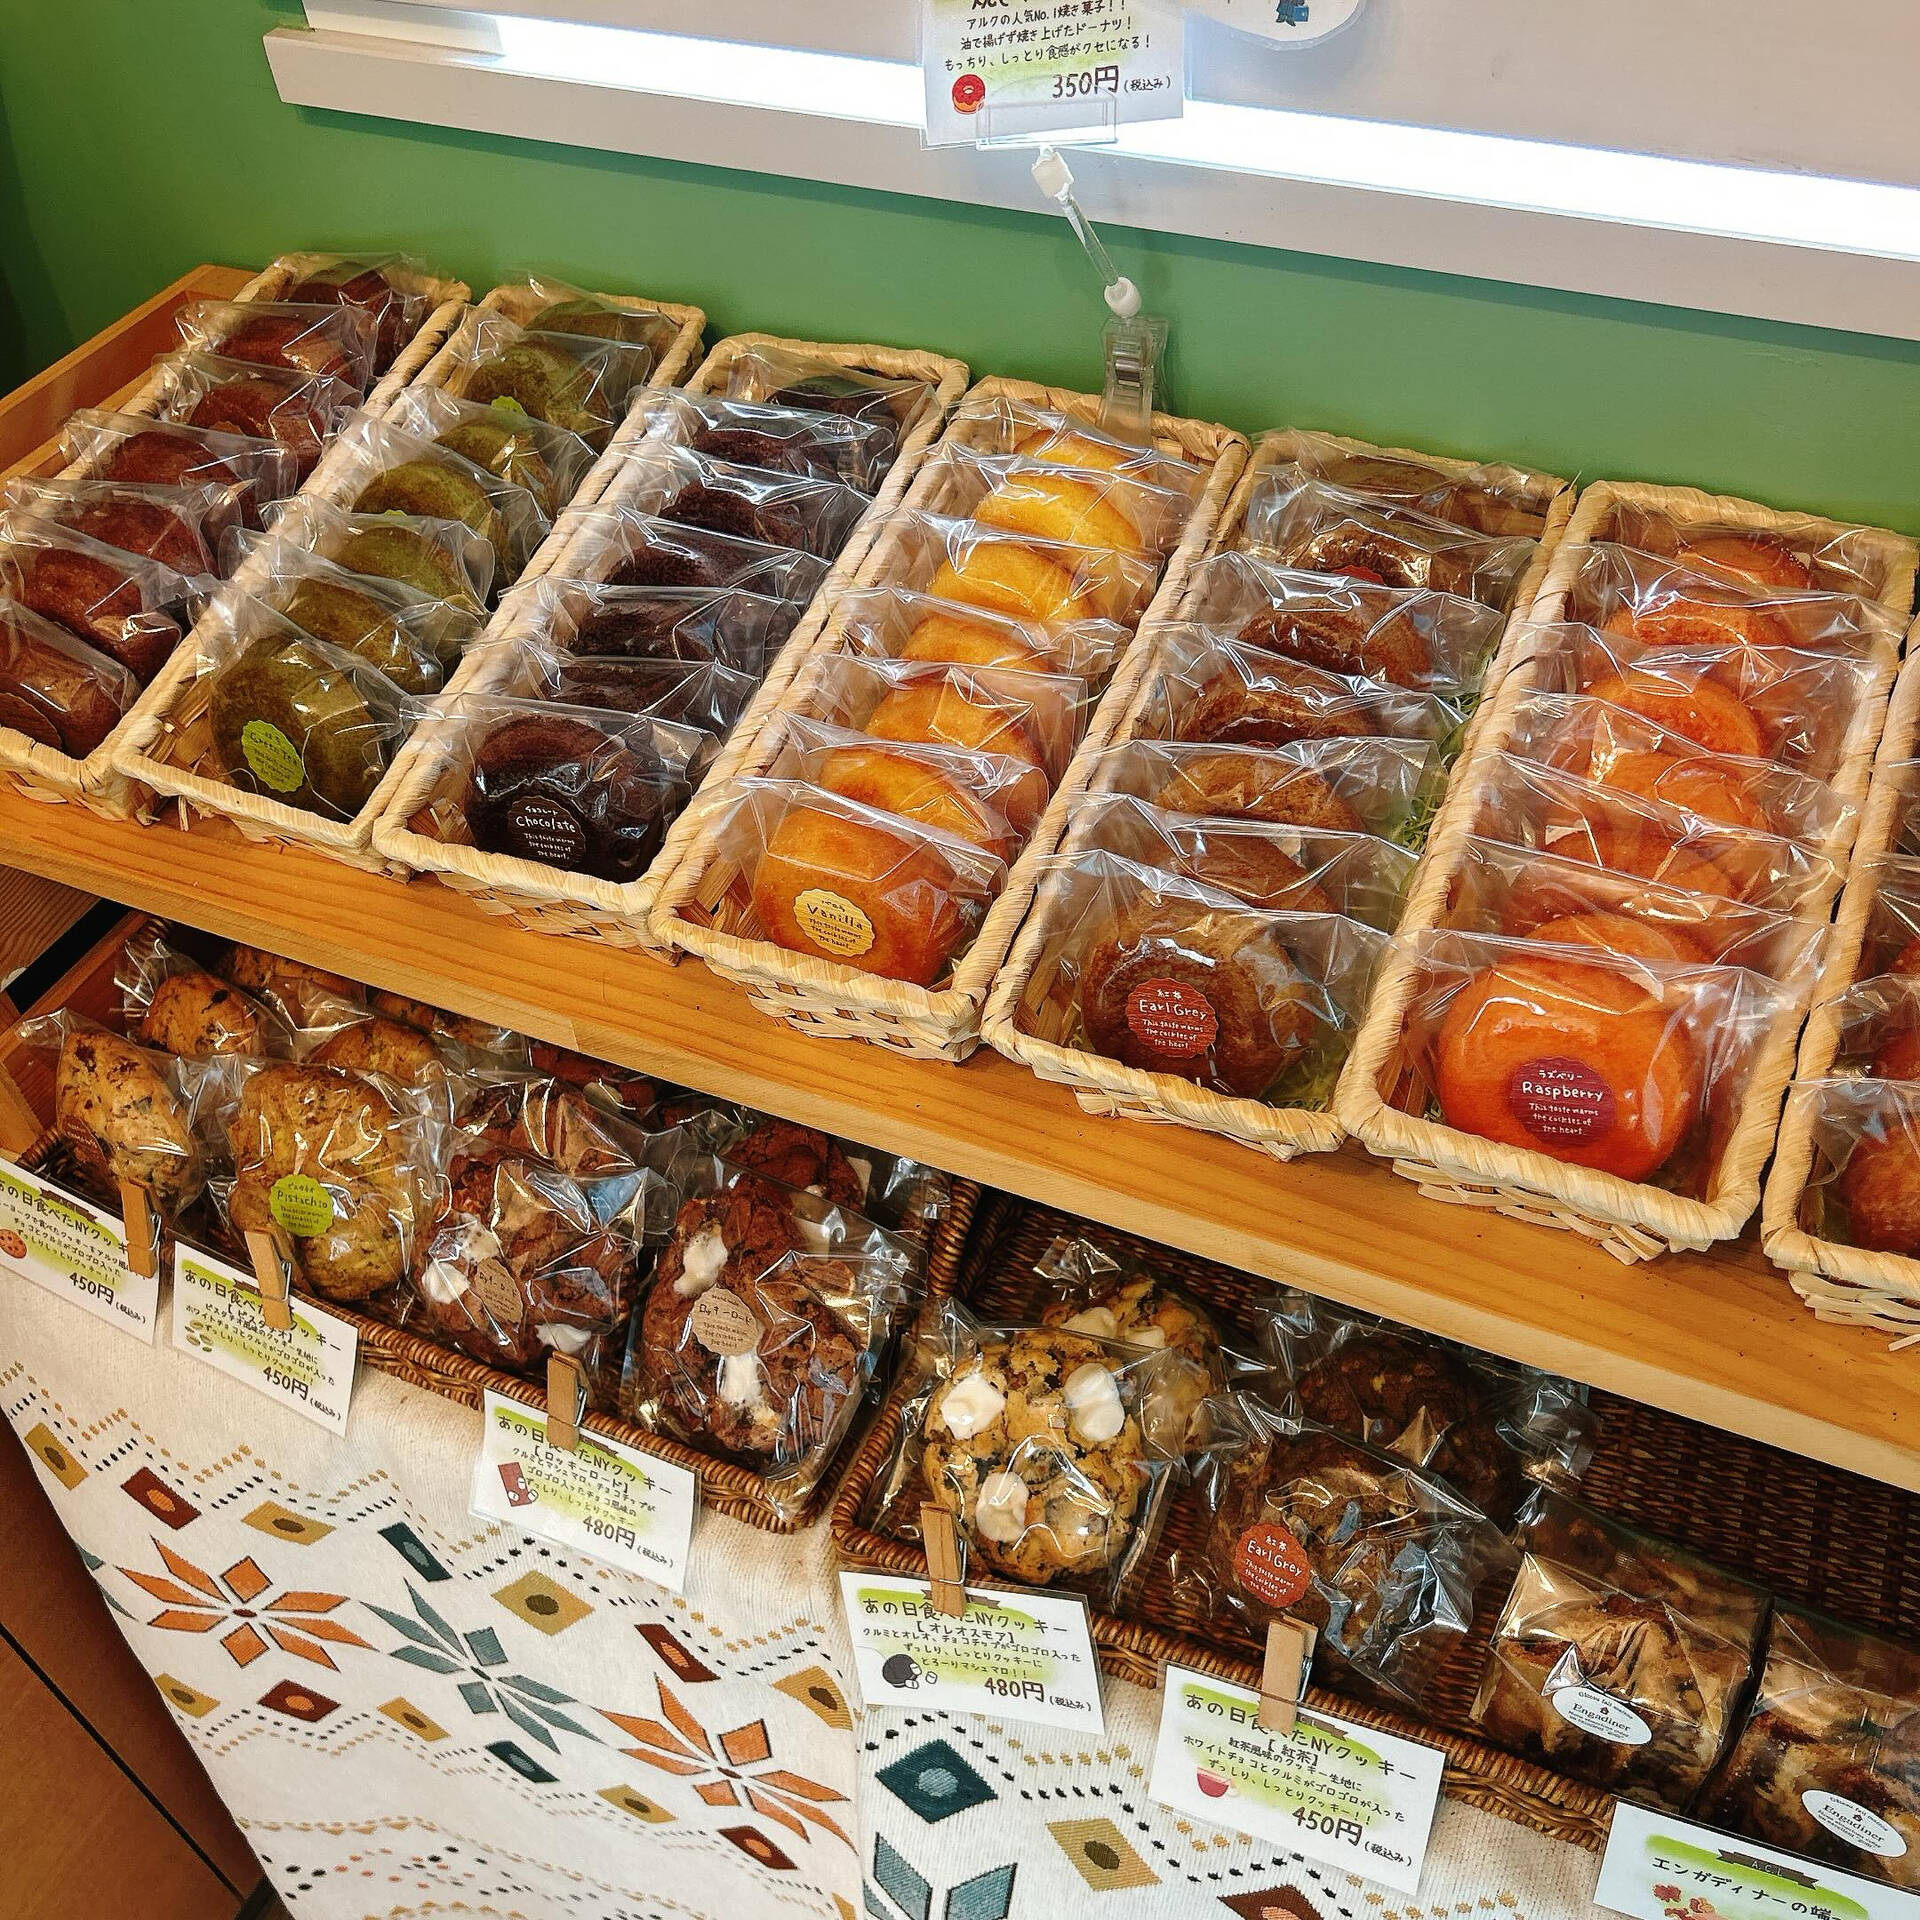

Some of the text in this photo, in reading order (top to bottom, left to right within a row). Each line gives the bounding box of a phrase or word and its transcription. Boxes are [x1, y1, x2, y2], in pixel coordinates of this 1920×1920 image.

[1052, 65, 1119, 98] 350円
[516, 815, 576, 833] Chocolate
[806, 902, 863, 931] Vanilla
[1139, 999, 1207, 1020] Earl Grey
[1522, 1081, 1603, 1102] Raspberry
[277, 1190, 328, 1208] Pistachio
[69, 1272, 114, 1306] 450円
[263, 1366, 309, 1400] 450円
[583, 1515, 637, 1550] 480円
[1247, 1539, 1303, 1577] Earl Grey
[984, 1677, 1044, 1703] 480円
[1573, 1703, 1631, 1731] Engadiner
[1291, 1806, 1363, 1847] 450円
[1823, 1804, 1885, 1842] Engadiner
